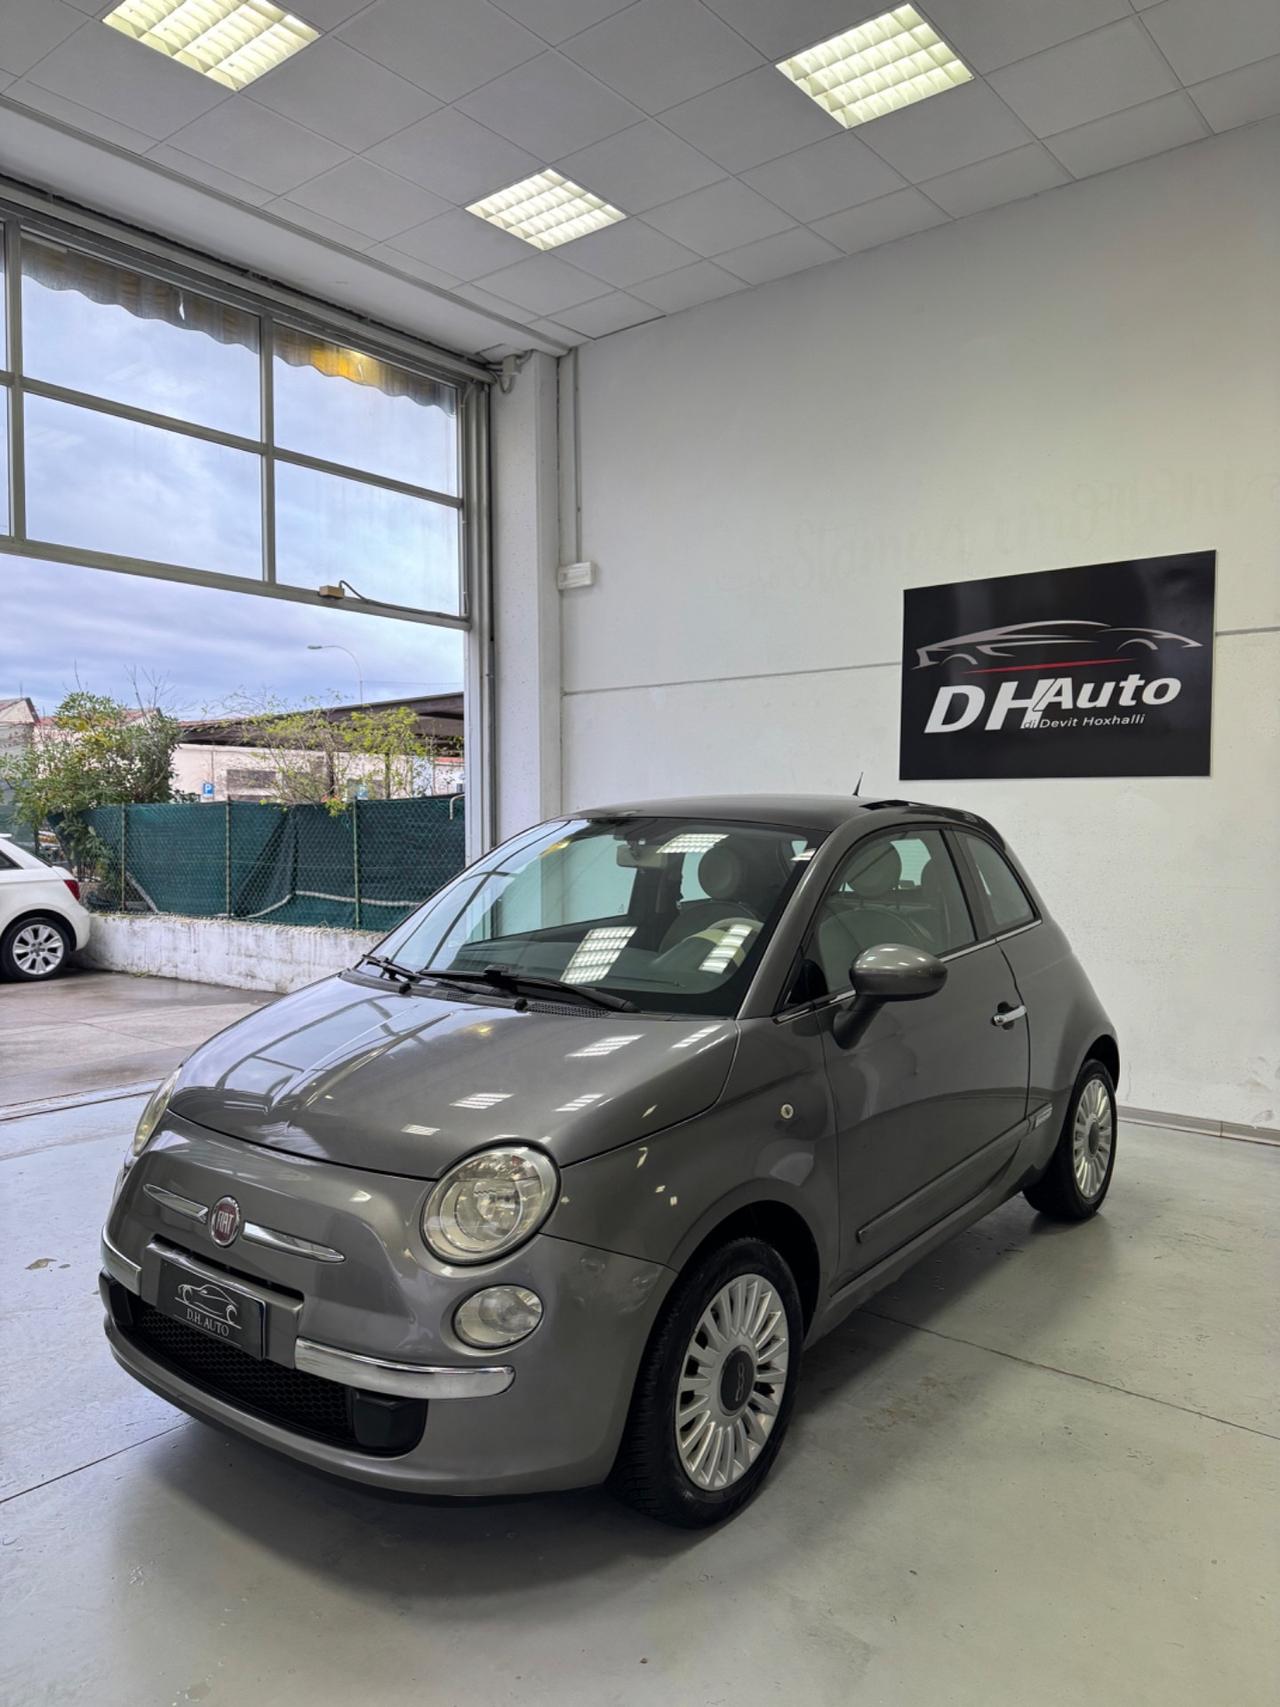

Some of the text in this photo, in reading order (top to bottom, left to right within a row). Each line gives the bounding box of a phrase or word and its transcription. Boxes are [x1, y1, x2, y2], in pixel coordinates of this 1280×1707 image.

[1040, 717, 1079, 728] Devit
[1082, 713, 1146, 727] Hoxhalli
[216, 1210, 234, 1234] FIAT
[203, 1317, 230, 1337] AUTO
